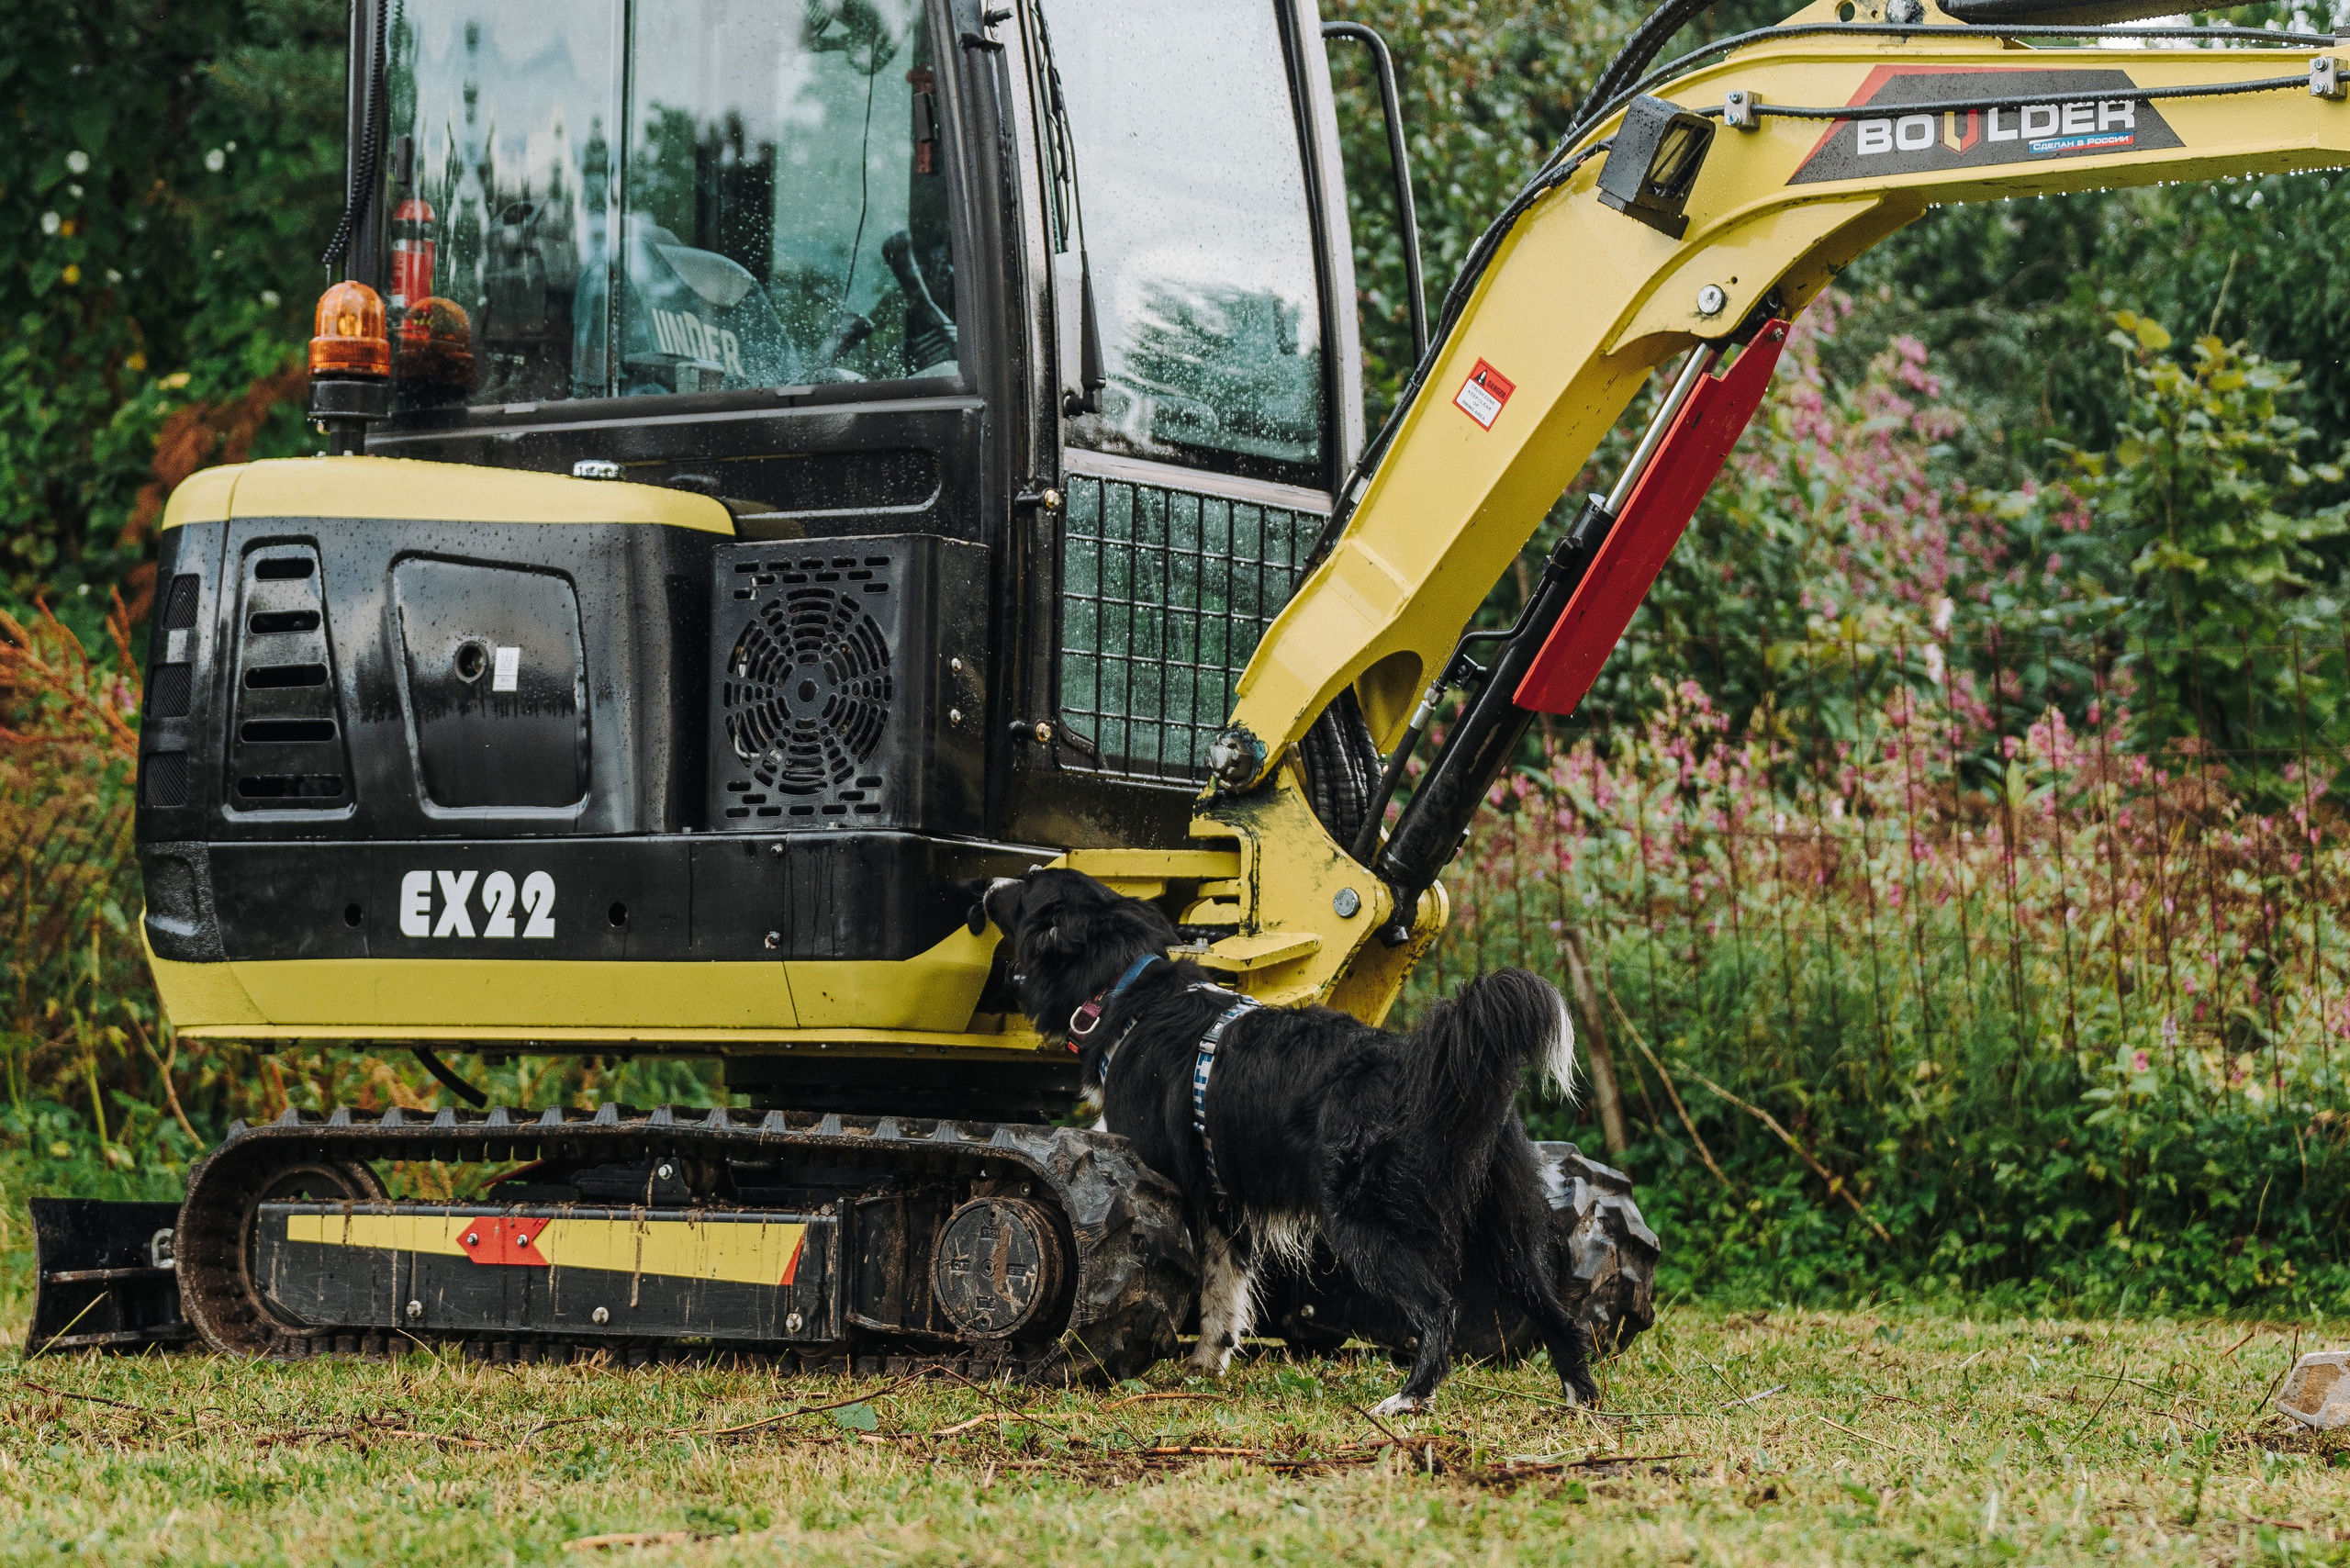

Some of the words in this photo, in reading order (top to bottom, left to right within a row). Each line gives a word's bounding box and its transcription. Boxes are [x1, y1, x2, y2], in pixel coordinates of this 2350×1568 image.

[1857, 99, 2136, 155] BOULDER
[1467, 390, 1479, 400] KEEP
[1477, 397, 1492, 411] CLEAR
[1471, 384, 1485, 397] CRUSH
[1483, 393, 1495, 406] ZONE
[1486, 380, 1506, 399] DANGER
[1461, 398, 1475, 412] SWING
[1474, 409, 1485, 421] AREA
[399, 869, 556, 938] EX22
